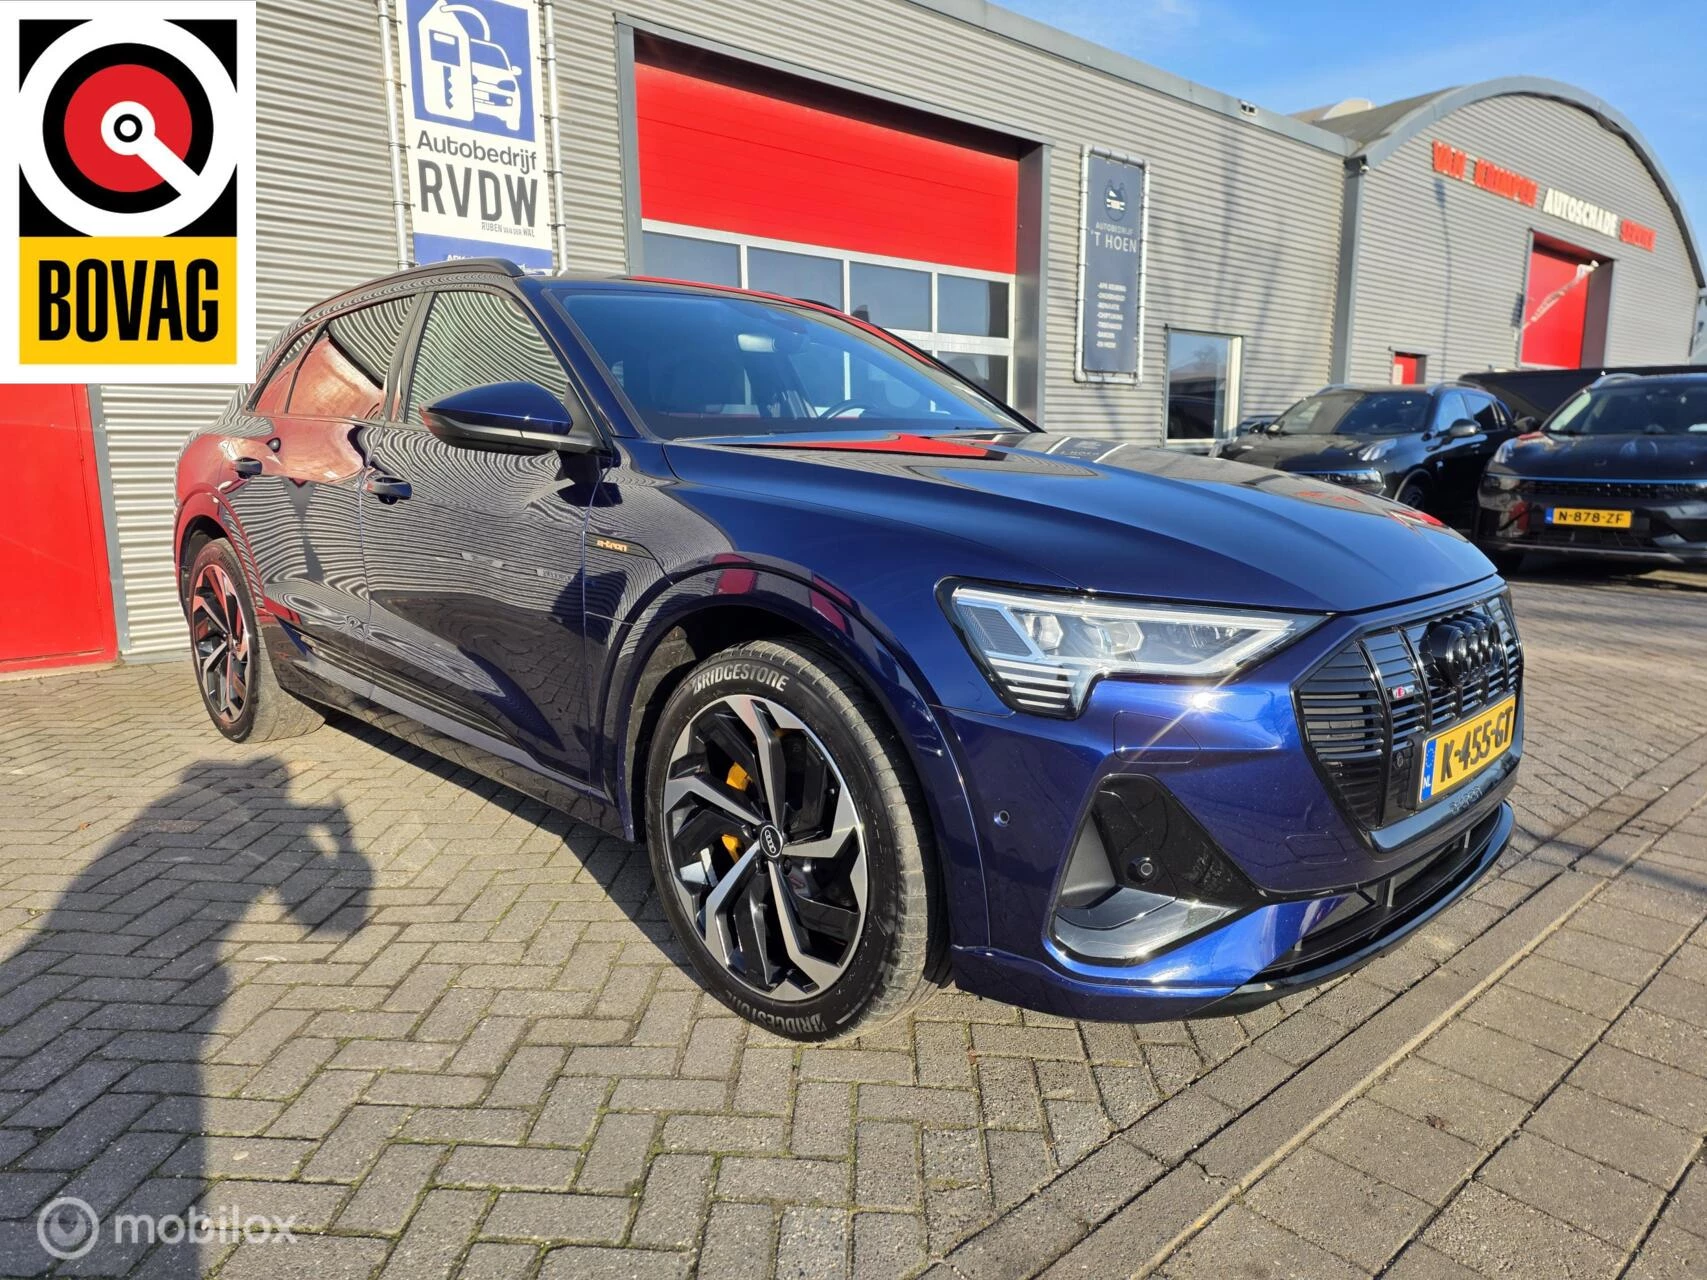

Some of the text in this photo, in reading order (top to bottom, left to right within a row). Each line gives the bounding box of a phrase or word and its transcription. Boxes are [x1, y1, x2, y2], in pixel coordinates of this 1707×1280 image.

[417, 130, 537, 175] Autobedrijf
[417, 158, 538, 228] RVDW
[481, 221, 502, 233] RUBEN
[1105, 233, 1137, 253] HOEN
[1558, 511, 1625, 524] N-878-ZF
[596, 539, 628, 553] e-tron
[692, 663, 790, 696] BRIDGESTONE
[1440, 706, 1514, 783] K-455-GT
[1423, 775, 1432, 789] NL
